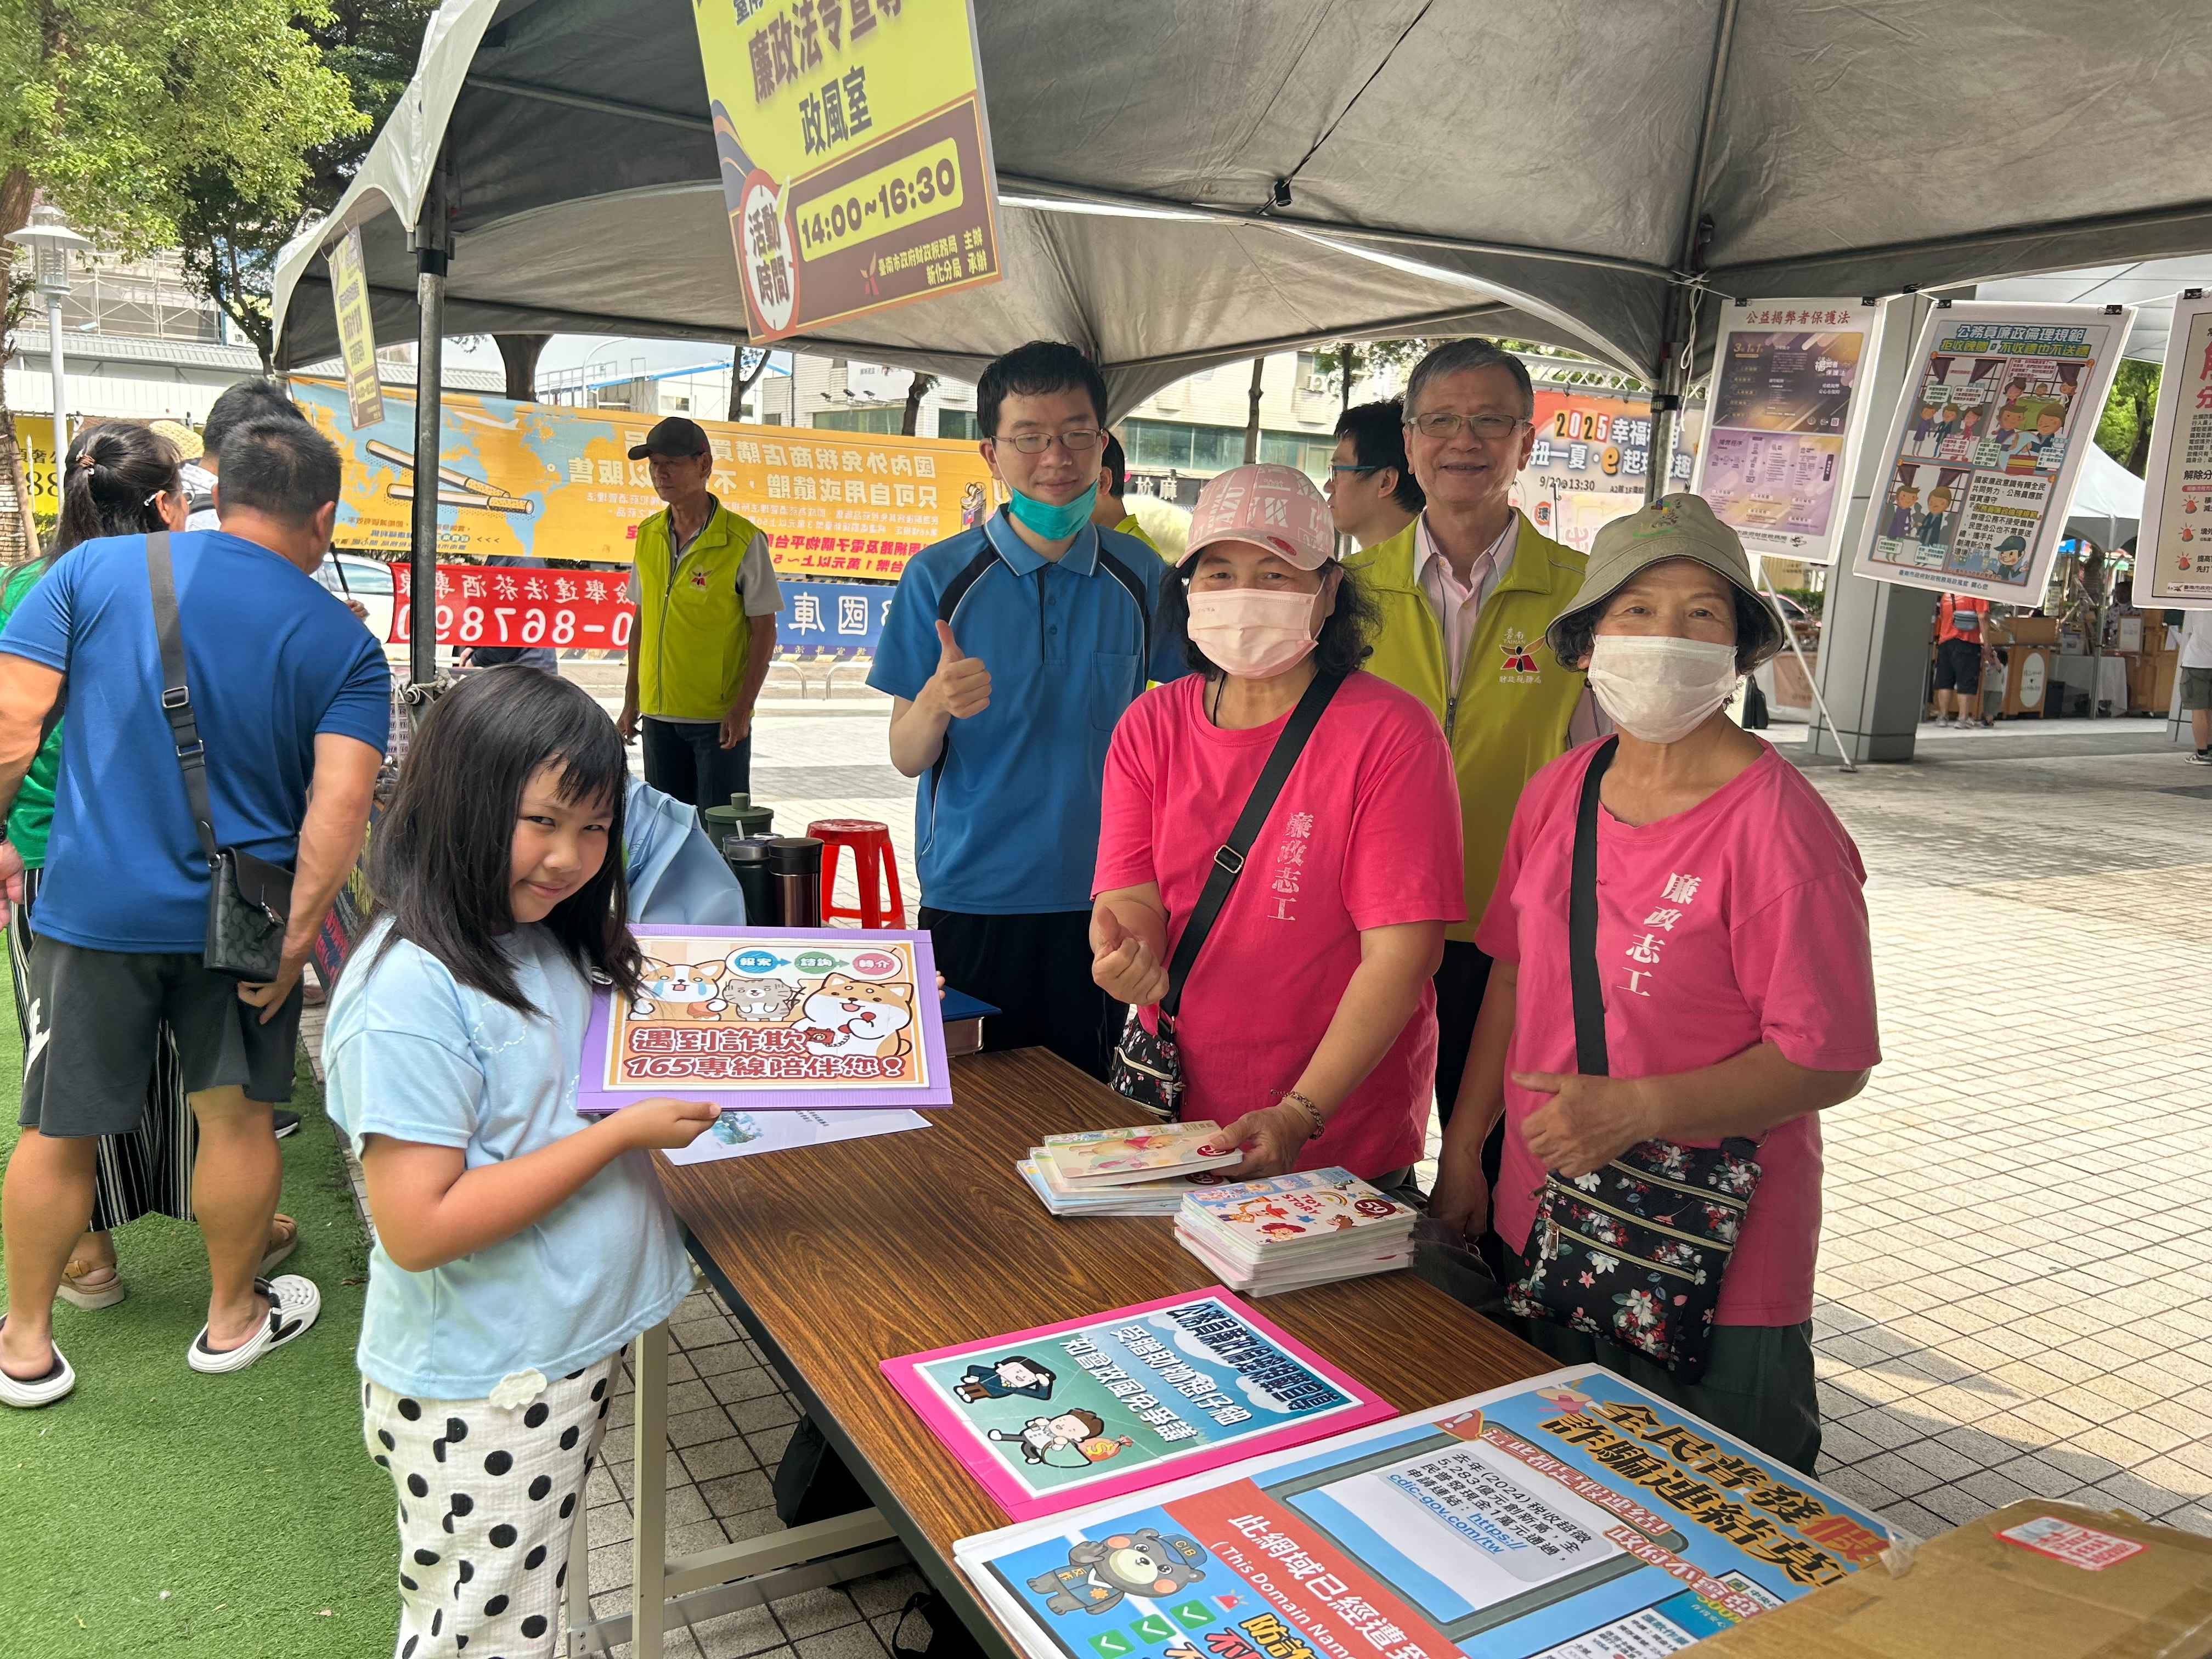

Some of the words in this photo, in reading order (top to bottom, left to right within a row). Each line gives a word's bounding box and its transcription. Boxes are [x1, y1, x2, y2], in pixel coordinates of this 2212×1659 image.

[749, 0, 901, 104] 廉政法令宣
[799, 65, 872, 156] 政風室
[802, 159, 955, 249] 14:00~16:30
[748, 204, 781, 258] 活動
[878, 234, 958, 276] 臺南市政府財政稅務局
[926, 257, 962, 286] 新化分局
[755, 255, 791, 307] 時間
[1746, 311, 1851, 325] 公益揭弊者保護法
[1957, 325, 2084, 343] 公務員廉政倫理規範
[1556, 411, 1609, 442] 2025
[1499, 675, 1542, 684] 財政稅務局
[1267, 812, 1314, 921] 廉政志工
[1617, 872, 1702, 996] 廉政志工
[740, 956, 773, 968] 報案
[858, 958, 890, 969] 轉介
[631, 1027, 807, 1054] 遇到詐欺
[1281, 1194, 1321, 1215] STORY
[1301, 1194, 1325, 1208] TOY
[1359, 1200, 1386, 1215] 59
[1110, 1323, 1253, 1426] 受贈財物想仔細
[1166, 1302, 1341, 1412] 公務員廉政倫理規範宣導
[1059, 1337, 1199, 1444] 知會政風免爭議
[1387, 1474, 1505, 1555] cdic-gov.com/tw
[1175, 1541, 1197, 1557] CIB
[1255, 1570, 1302, 1622] Domain
